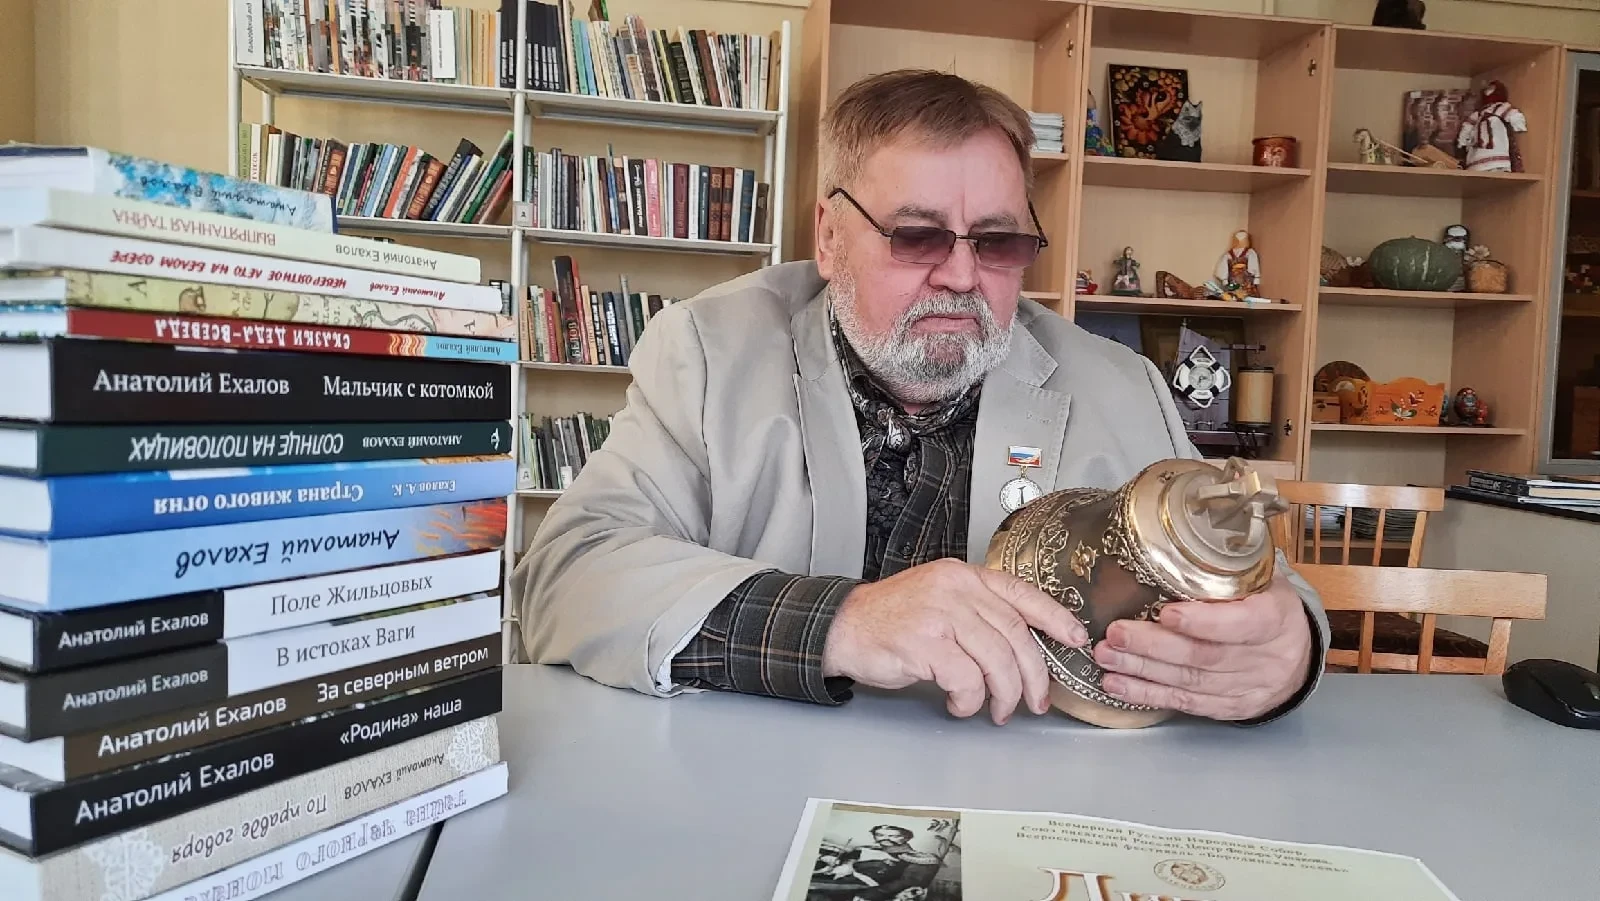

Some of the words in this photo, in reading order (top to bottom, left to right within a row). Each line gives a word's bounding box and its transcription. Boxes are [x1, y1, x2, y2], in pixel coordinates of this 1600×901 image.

[112, 208, 167, 229] ТАЙНА
[170, 214, 276, 246] ВЫПРЯТАННАЯ
[110, 250, 154, 265] ОЗЕРЕ
[335, 244, 379, 261] Ехалов
[383, 251, 437, 270] Анатолий
[160, 256, 206, 273] БЕЛОМ
[211, 262, 229, 275] НА
[234, 265, 263, 280] ЛЕТО
[268, 270, 347, 289] НЕВЕРОЯТНОЕ
[369, 281, 399, 295] Ехалов
[402, 286, 445, 300] Анатолий
[293, 329, 351, 350] СКАЗКИ
[436, 342, 463, 354] Ехалов
[465, 344, 501, 356] Анатолий
[93, 369, 213, 394] Анатолий
[218, 372, 290, 395] Ехалов
[323, 375, 403, 398] Мальчик
[407, 382, 416, 398] с
[420, 382, 494, 400] котомкой
[128, 432, 249, 463] ПОЛОВИЦАХ
[252, 435, 276, 457] НА
[277, 430, 344, 457] СОЛНЦЕ
[363, 435, 405, 448] ЕХАЛОВ
[407, 434, 462, 448] АНАТОЛИЙ
[298, 481, 364, 502] Страна
[418, 480, 456, 493] Ехалов
[153, 495, 208, 515] огня
[214, 489, 293, 510] живого
[281, 529, 400, 564] Анатолий
[175, 542, 269, 579] Ехалов
[271, 593, 321, 616] Поле
[326, 575, 433, 606] Жильцовых
[58, 621, 146, 650] Анатолий
[151, 612, 209, 634] Ехалов
[277, 647, 289, 667] В
[296, 635, 371, 664] истоках
[375, 625, 416, 646] Ваги
[317, 683, 339, 703] За
[344, 662, 430, 696] северным
[434, 647, 489, 672] ветром
[62, 679, 147, 711] Анатолий
[152, 669, 209, 692] Ехалов
[98, 712, 210, 757] Анатолий
[215, 697, 287, 728] Ехалов
[339, 711, 419, 746] «Родина»
[424, 698, 463, 722] наша
[396, 752, 445, 782] Анатолий
[75, 771, 193, 826] Анатолий
[200, 752, 275, 789] Ехалов
[344, 774, 393, 800] ЕХАЛОВ
[306, 793, 328, 815] По
[241, 801, 301, 840] правде
[171, 826, 235, 865] говоря
[1016, 832, 1118, 849] Всероссийский
[1128, 829, 1182, 842] Русский
[184, 862, 284, 901] монах
